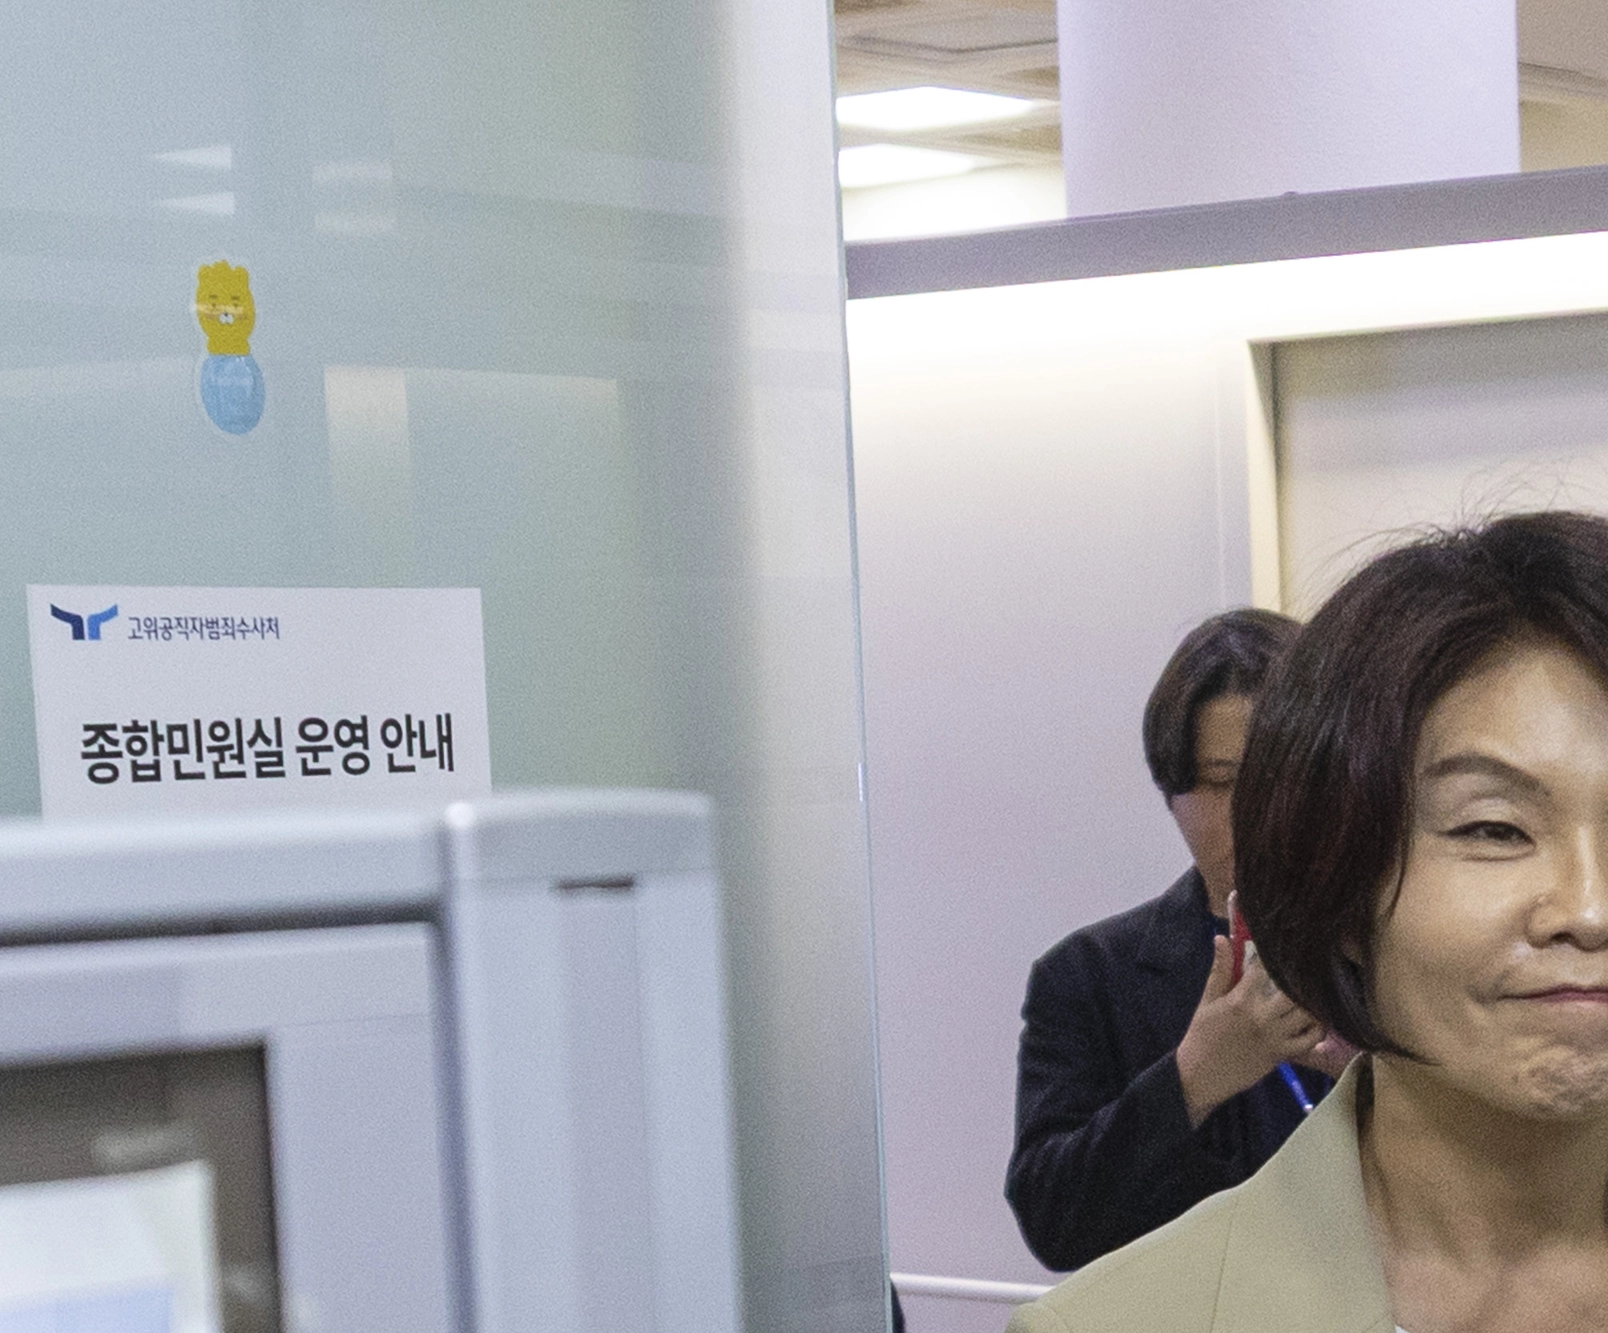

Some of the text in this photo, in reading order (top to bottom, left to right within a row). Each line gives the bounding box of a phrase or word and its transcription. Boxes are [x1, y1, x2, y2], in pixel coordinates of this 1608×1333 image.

[128, 617, 279, 641] 고위공직자범죄수사처
[81, 713, 454, 784] 종합민원실 운영 안내
